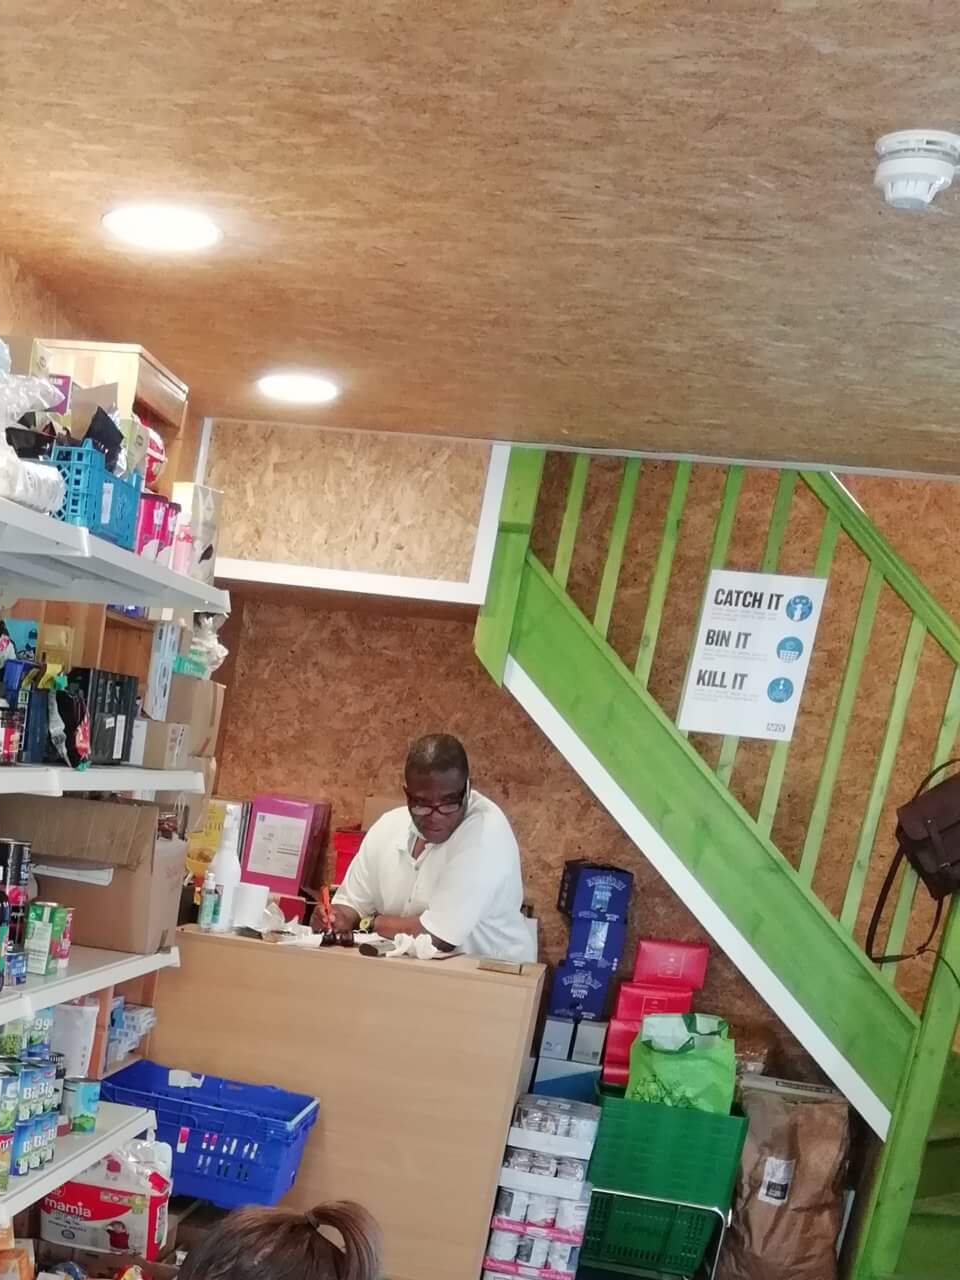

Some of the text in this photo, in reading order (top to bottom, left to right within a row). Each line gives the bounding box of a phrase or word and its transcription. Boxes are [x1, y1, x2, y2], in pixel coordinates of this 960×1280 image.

[714, 588, 784, 611] CATCH IT
[705, 629, 751, 649] BIN IT
[696, 669, 748, 690] KILL IT
[44, 1198, 91, 1218] mamia
